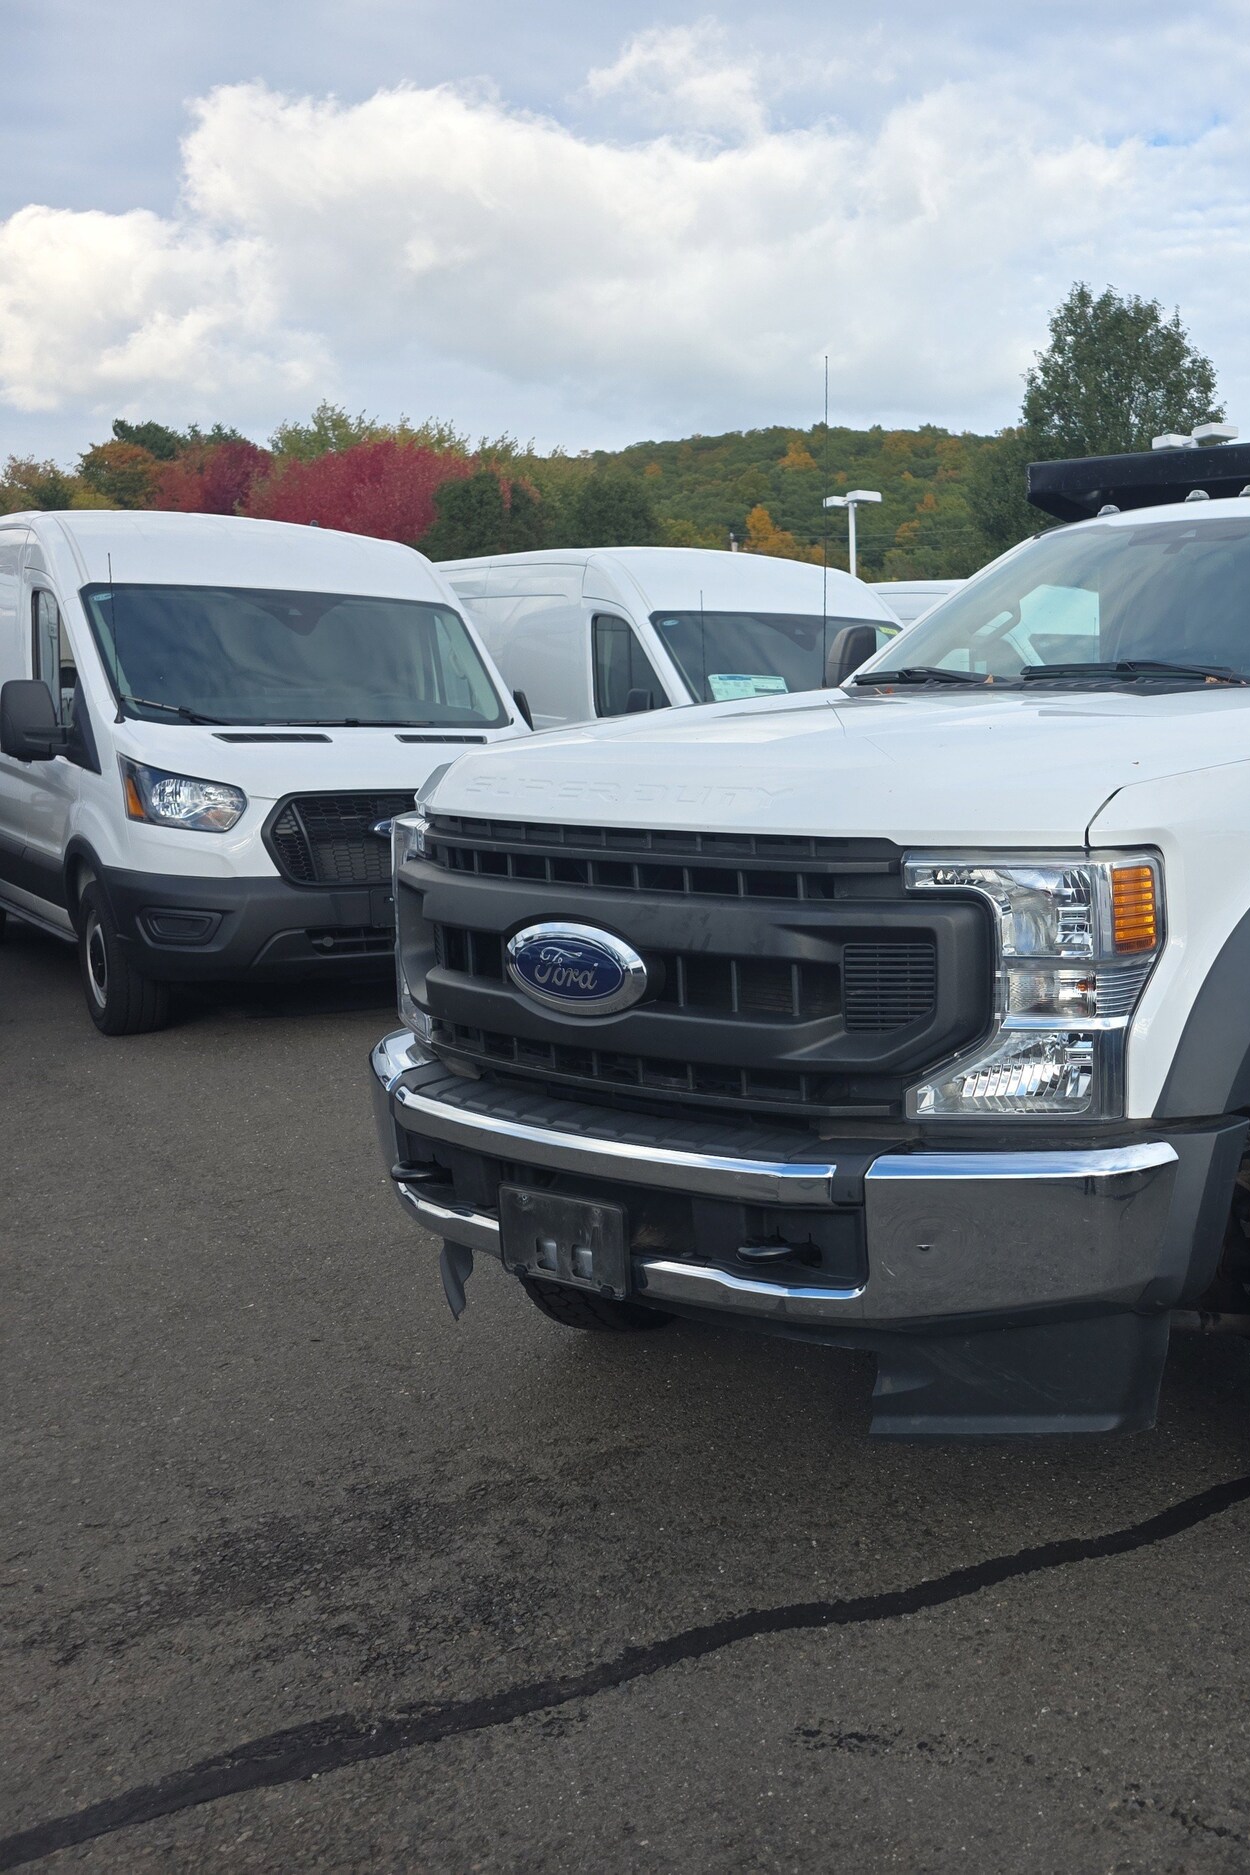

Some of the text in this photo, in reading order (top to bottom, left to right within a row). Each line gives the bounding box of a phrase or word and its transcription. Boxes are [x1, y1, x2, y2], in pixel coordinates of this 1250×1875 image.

[465, 775, 795, 808] SUPER DUTY
[534, 946, 598, 990] Ford
